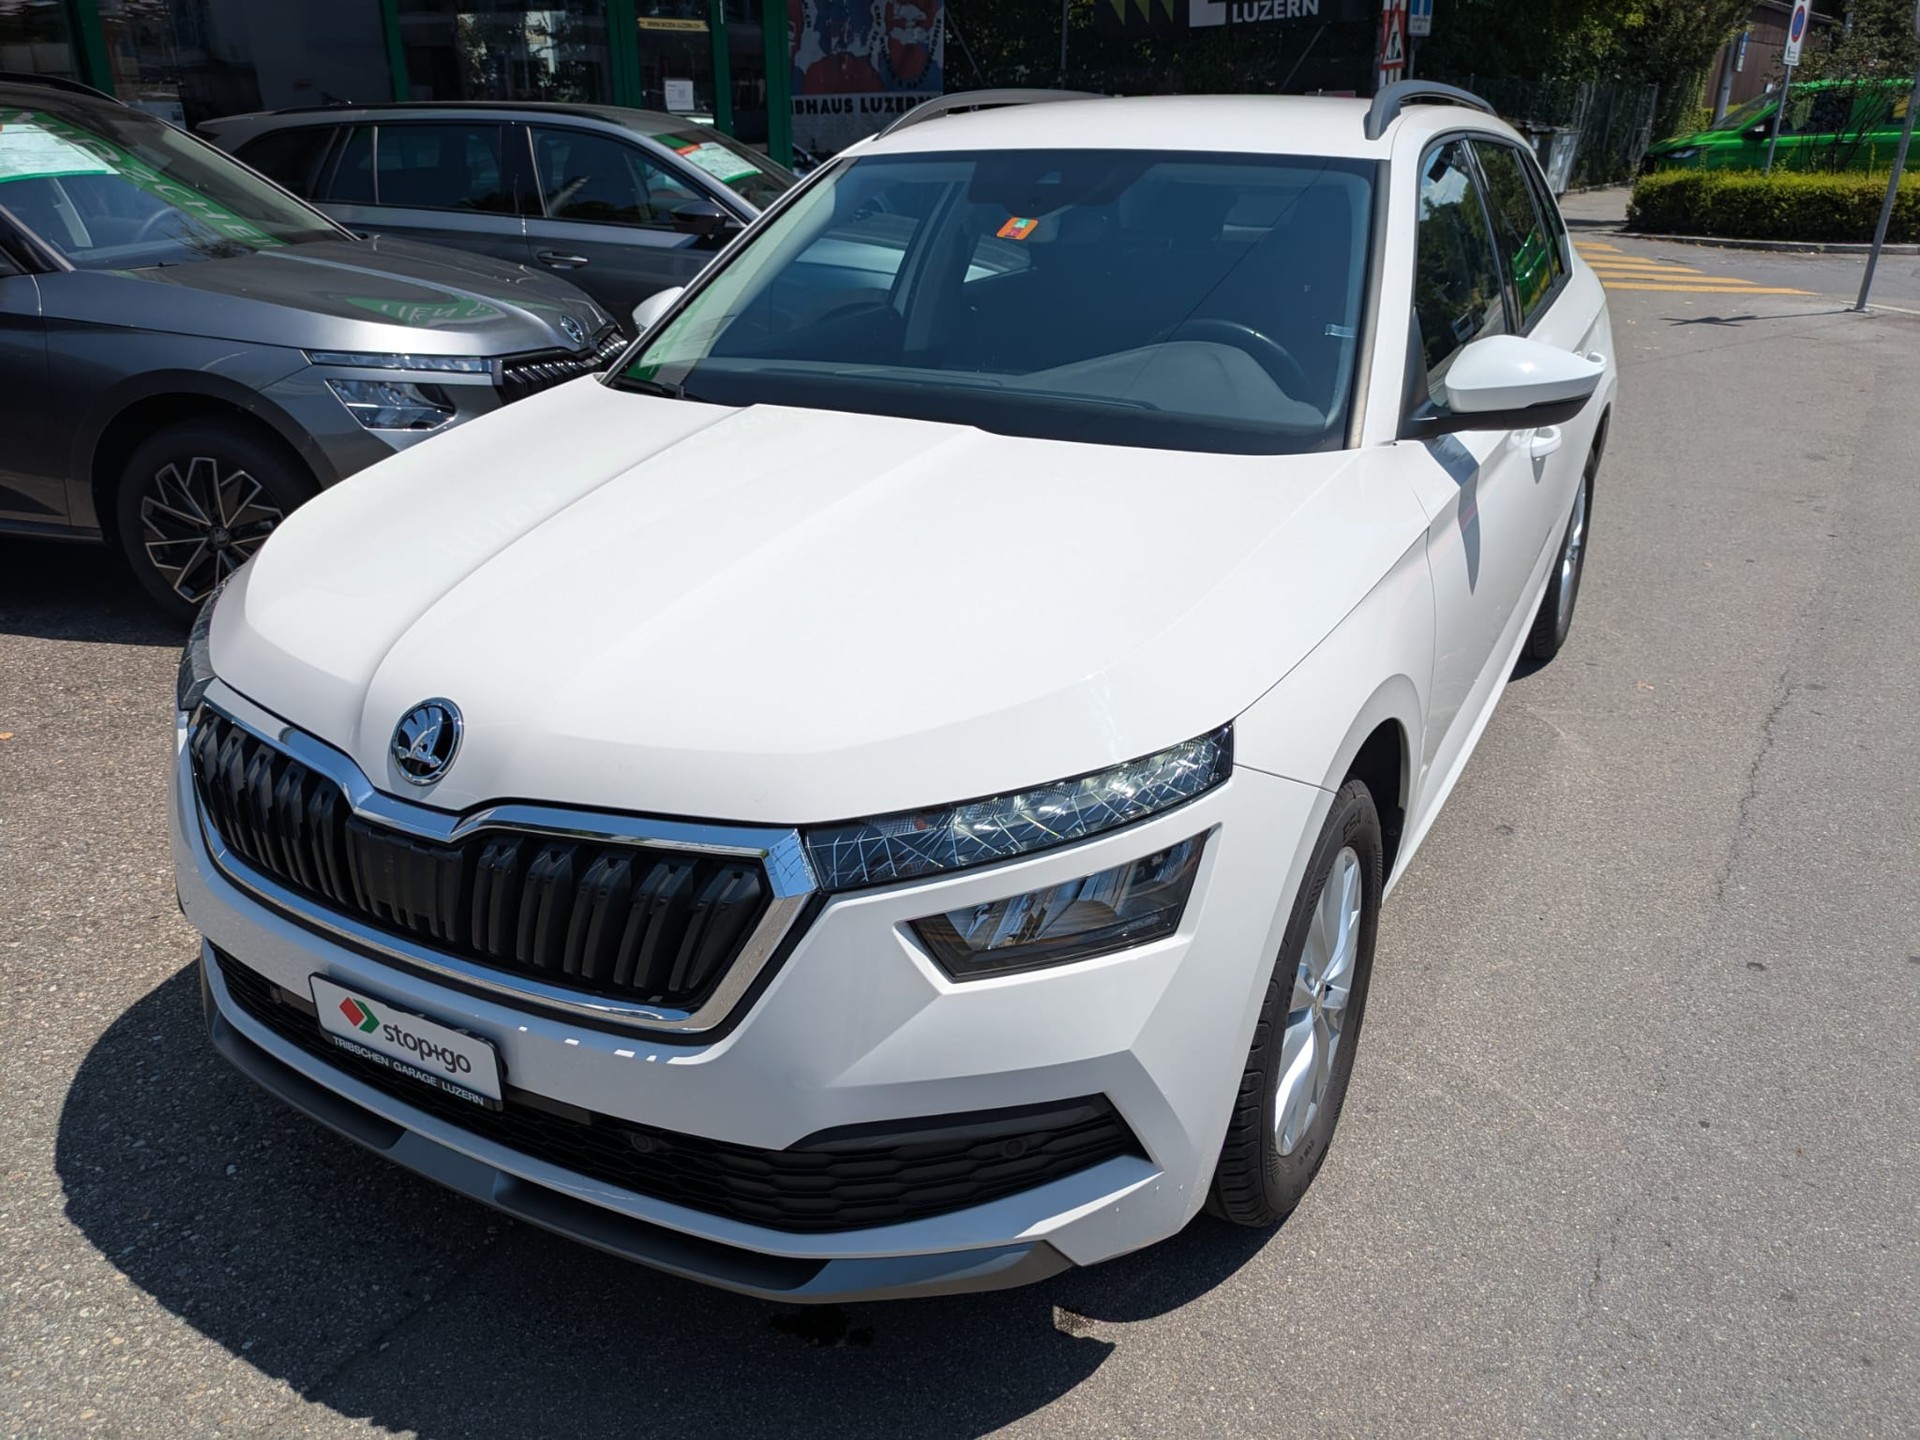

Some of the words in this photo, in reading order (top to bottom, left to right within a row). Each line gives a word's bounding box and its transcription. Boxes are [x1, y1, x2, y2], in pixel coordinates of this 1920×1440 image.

[1232, 0, 1319, 23] LUZERN
[791, 97, 854, 115] BHAUS
[383, 1022, 472, 1074] stop+go
[333, 1036, 390, 1067] TRIBSCHEN
[393, 1062, 438, 1087] GARAGE
[441, 1081, 484, 1106] LUZERN
